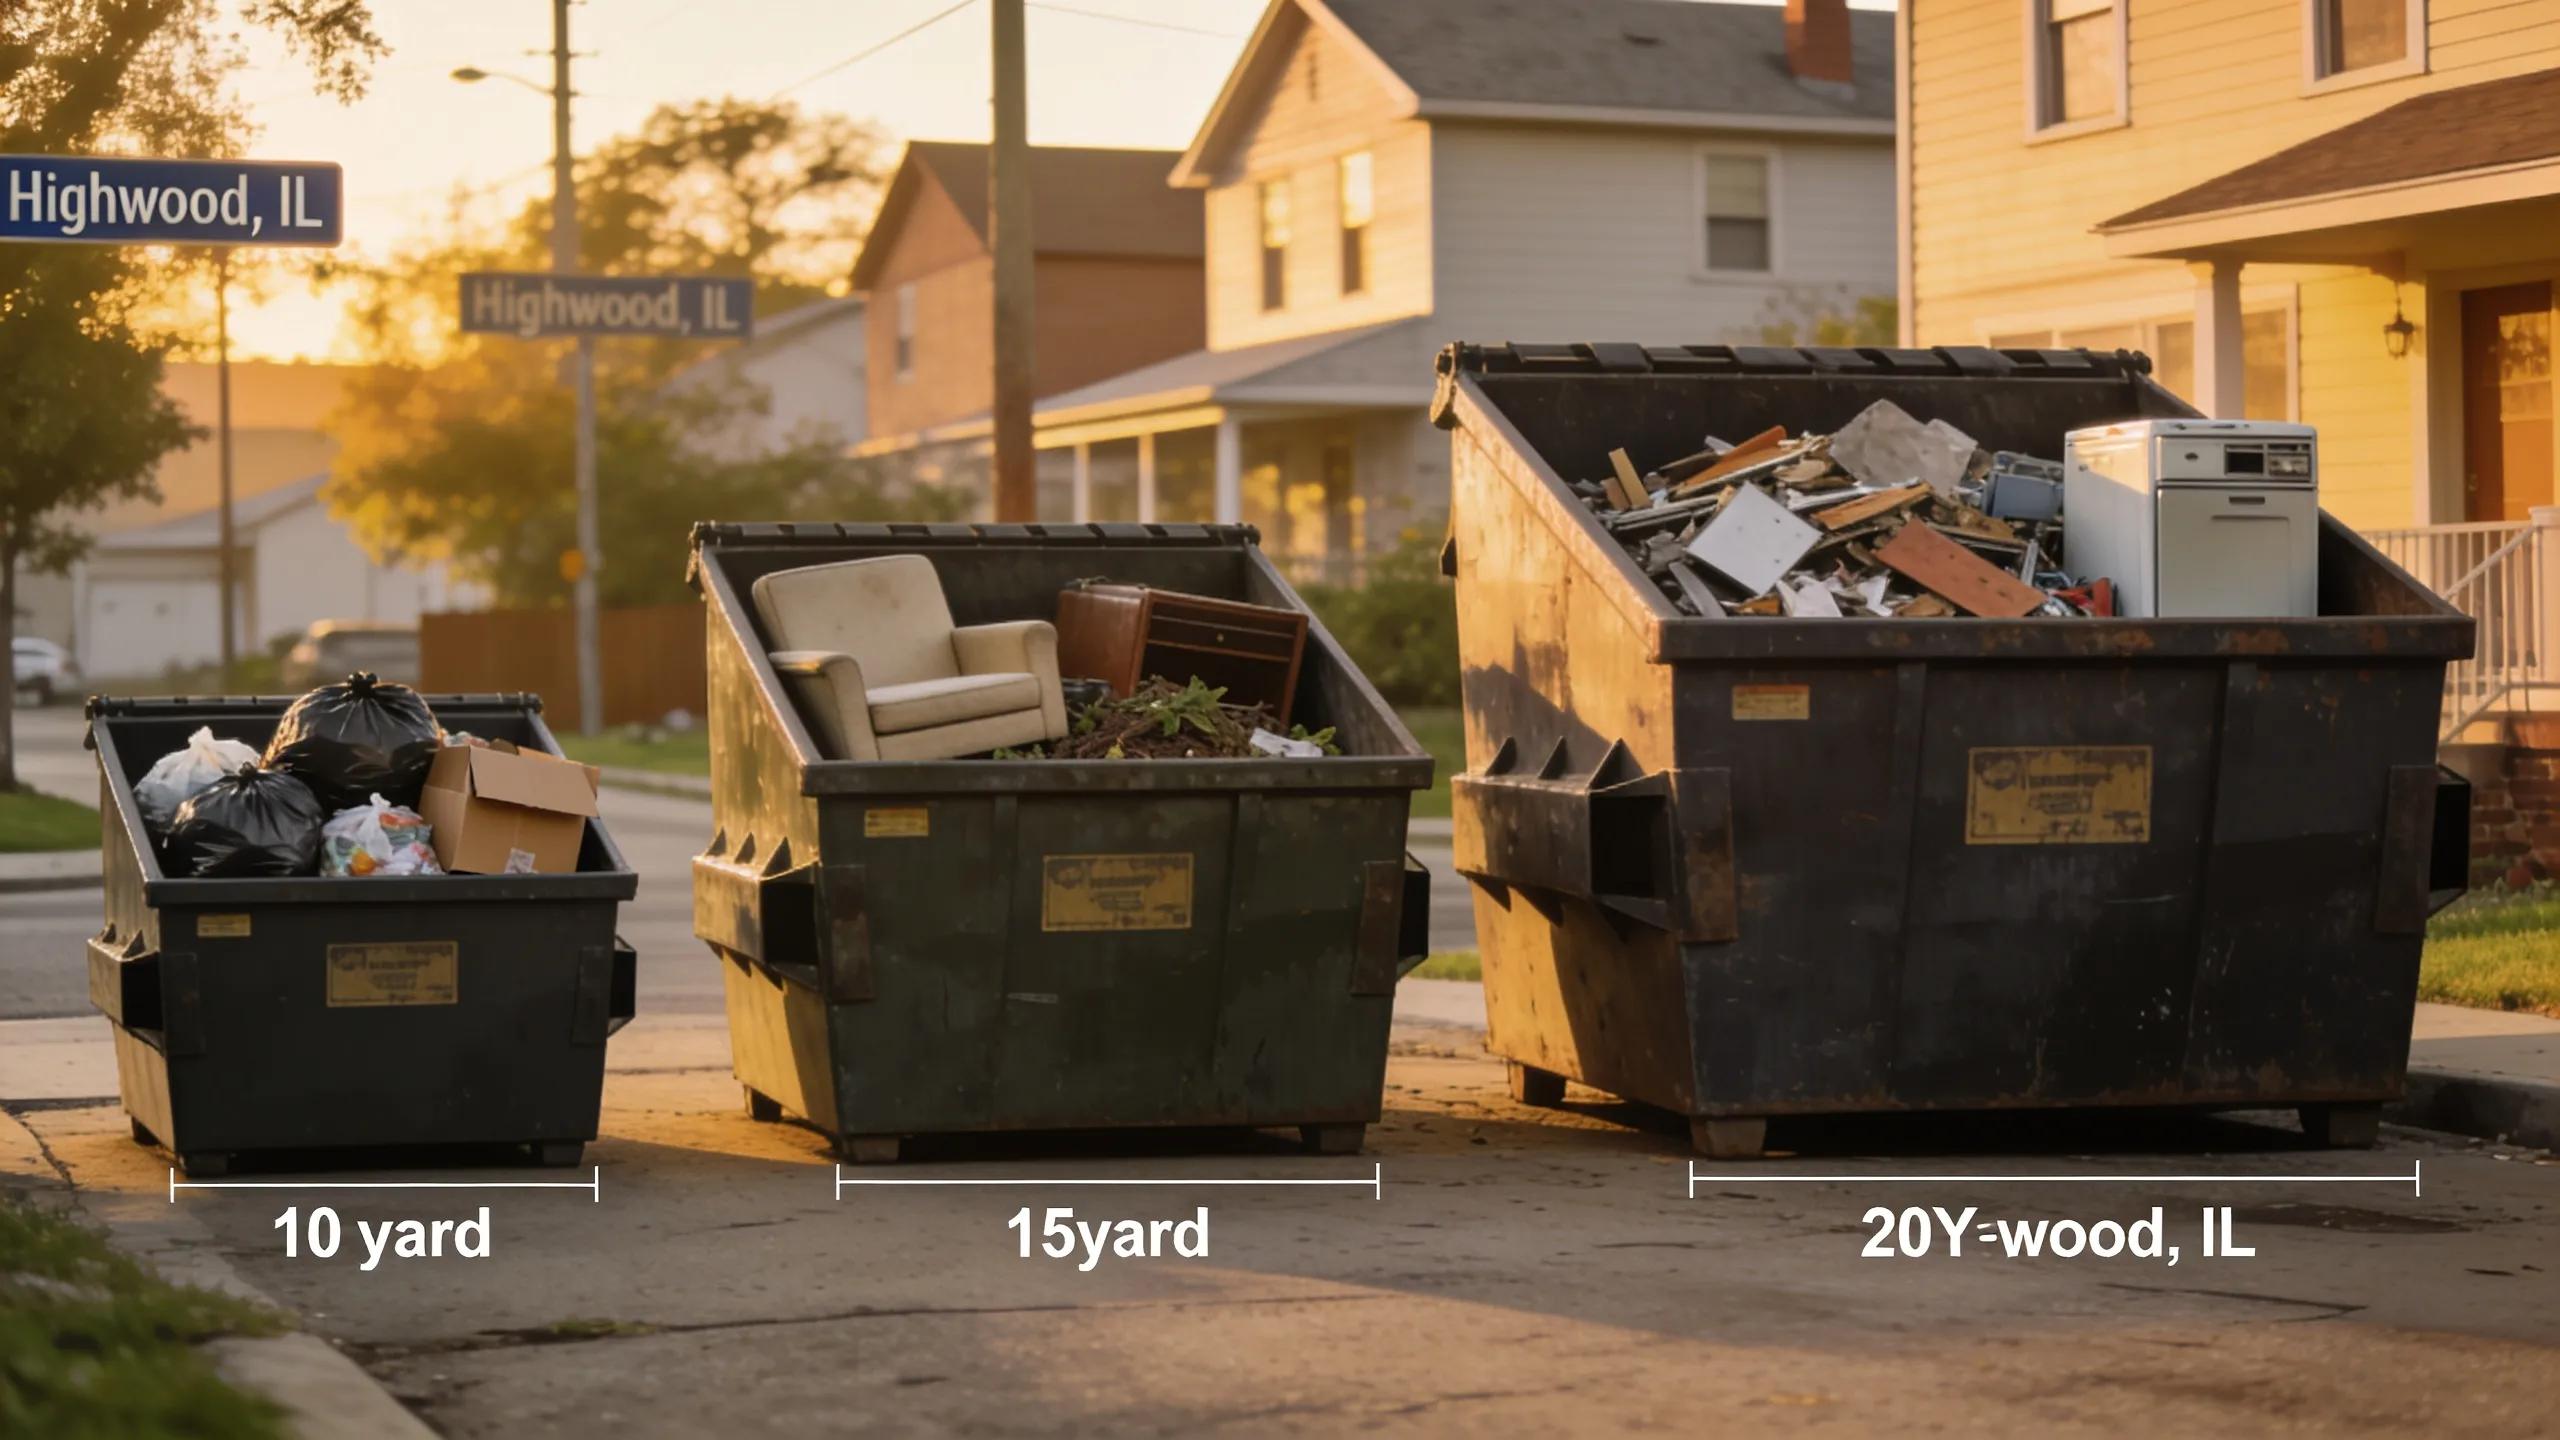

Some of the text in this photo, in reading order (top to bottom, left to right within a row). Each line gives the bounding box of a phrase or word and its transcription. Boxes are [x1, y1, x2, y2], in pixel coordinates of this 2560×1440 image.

[9, 170, 324, 237] Highwood, IL
[472, 280, 741, 338] Highwood, IL
